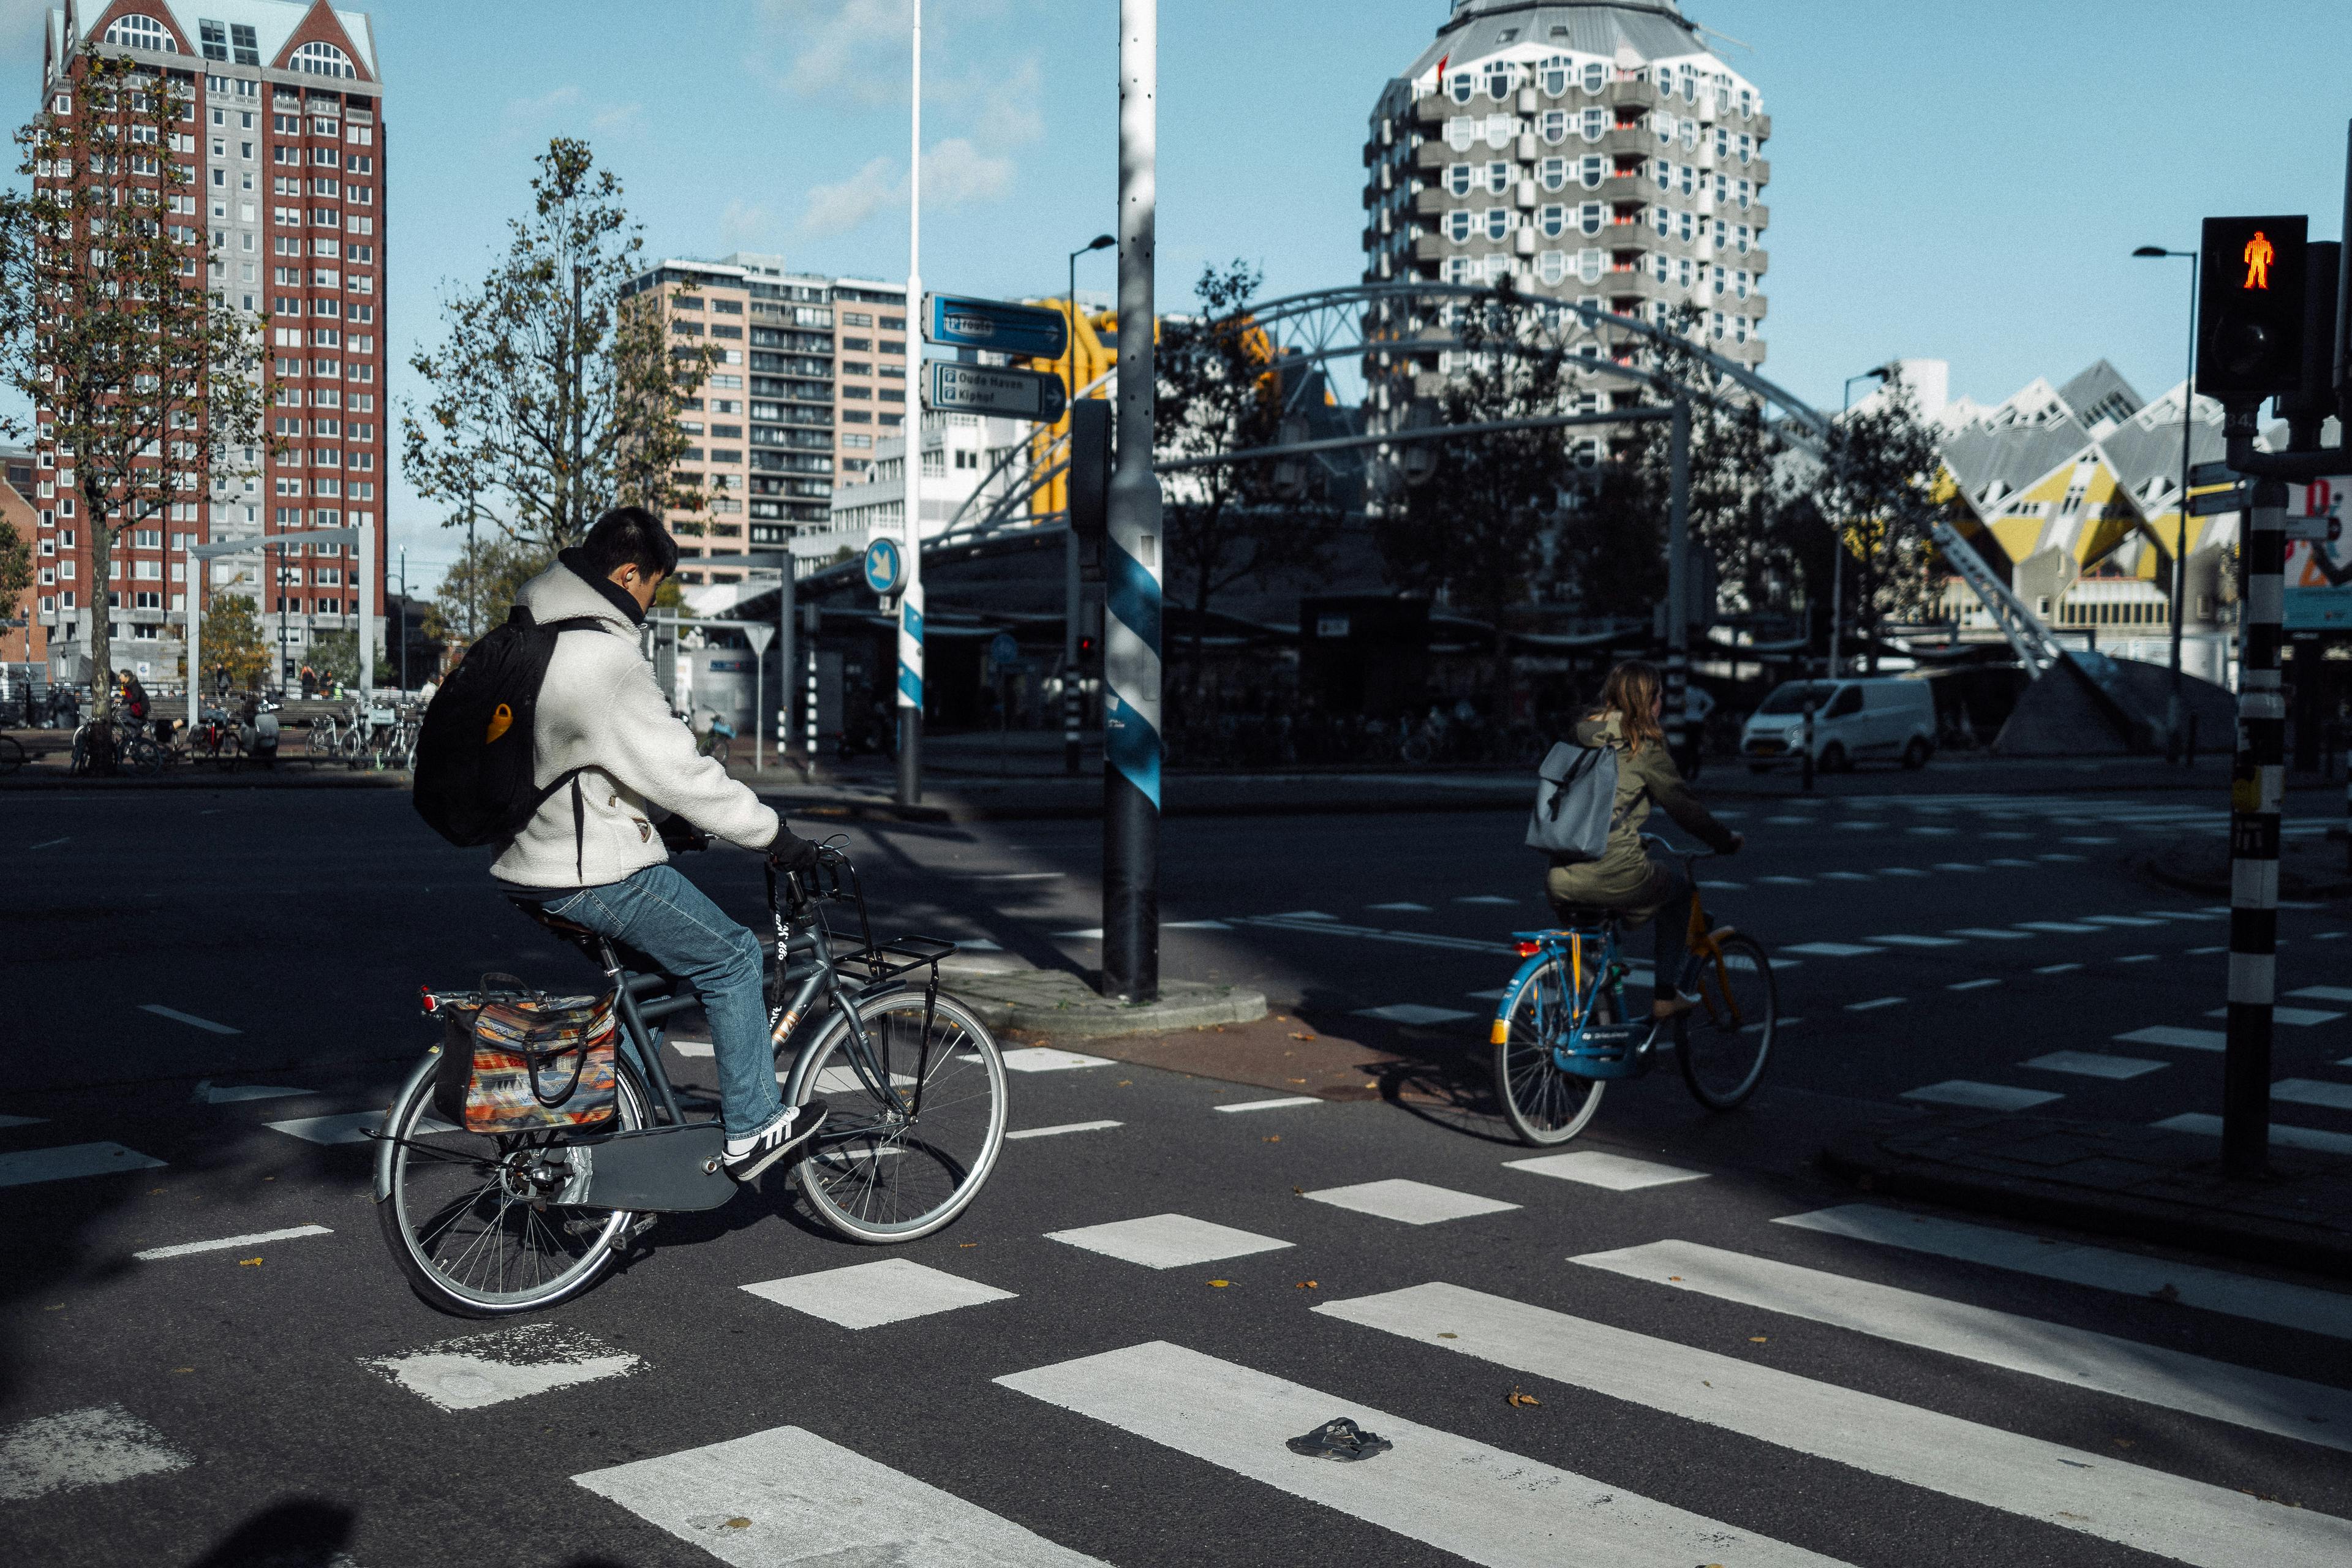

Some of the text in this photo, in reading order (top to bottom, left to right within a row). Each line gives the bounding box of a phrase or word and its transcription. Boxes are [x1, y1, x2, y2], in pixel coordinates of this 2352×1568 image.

[959, 372, 987, 386] Oude
[990, 377, 1023, 388] Haven
[959, 389, 995, 402] Kiphof
